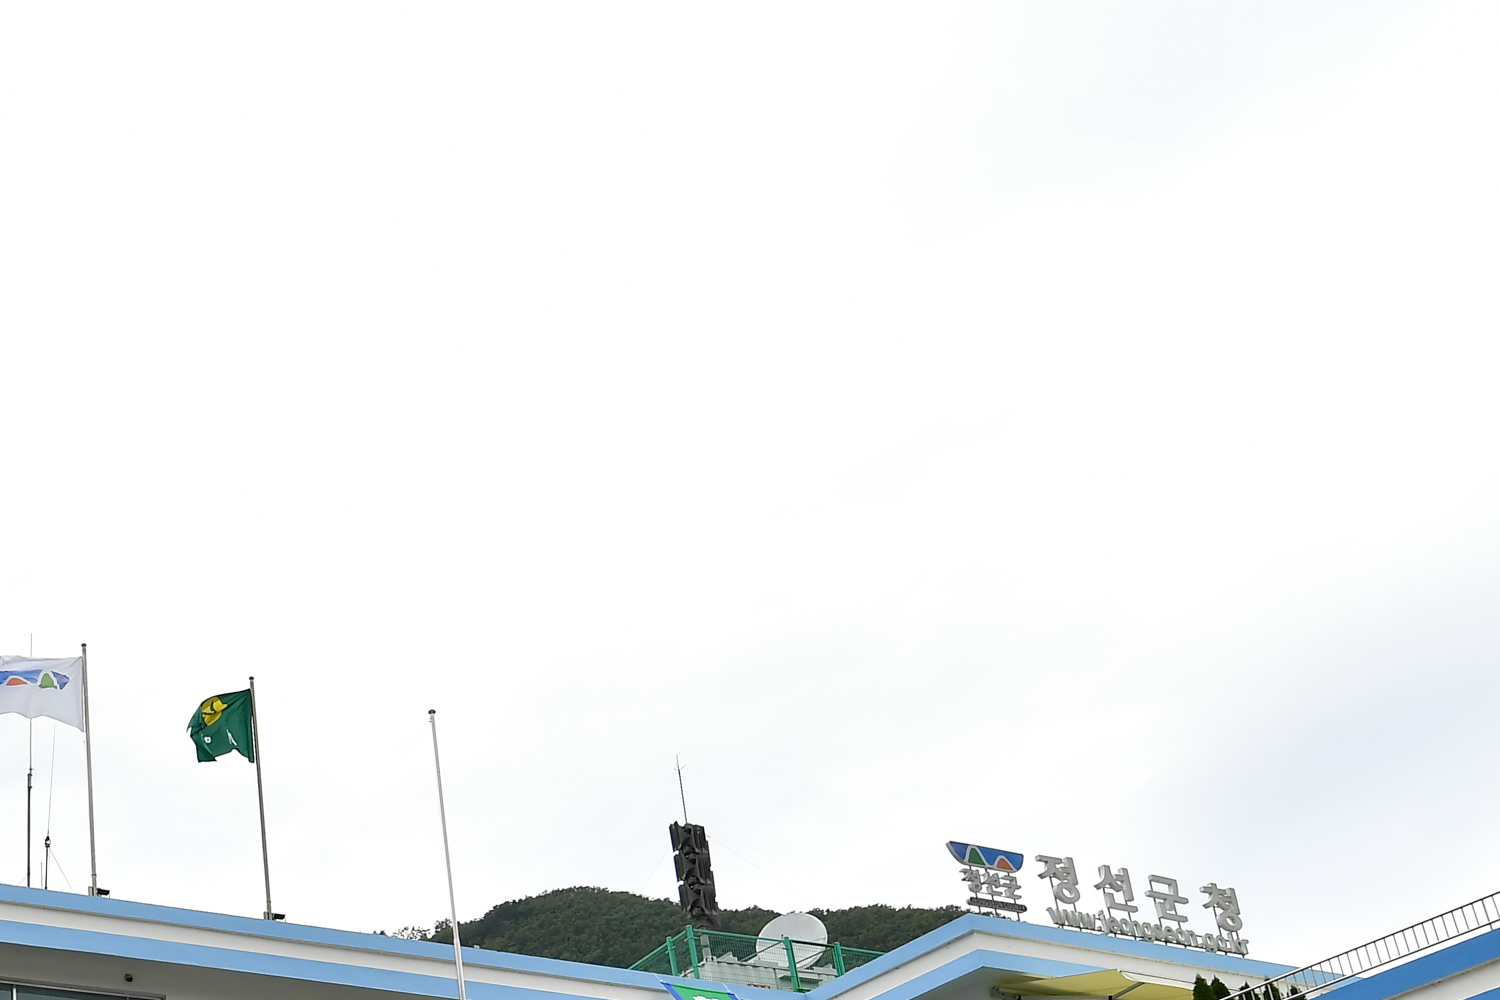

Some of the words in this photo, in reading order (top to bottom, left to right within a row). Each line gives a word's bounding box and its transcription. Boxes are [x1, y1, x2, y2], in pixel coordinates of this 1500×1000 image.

[959, 868, 1022, 899] 정선군
[1035, 855, 1244, 932] 정선군청
[1046, 906, 1249, 955] www.jeongseon.go.kr
